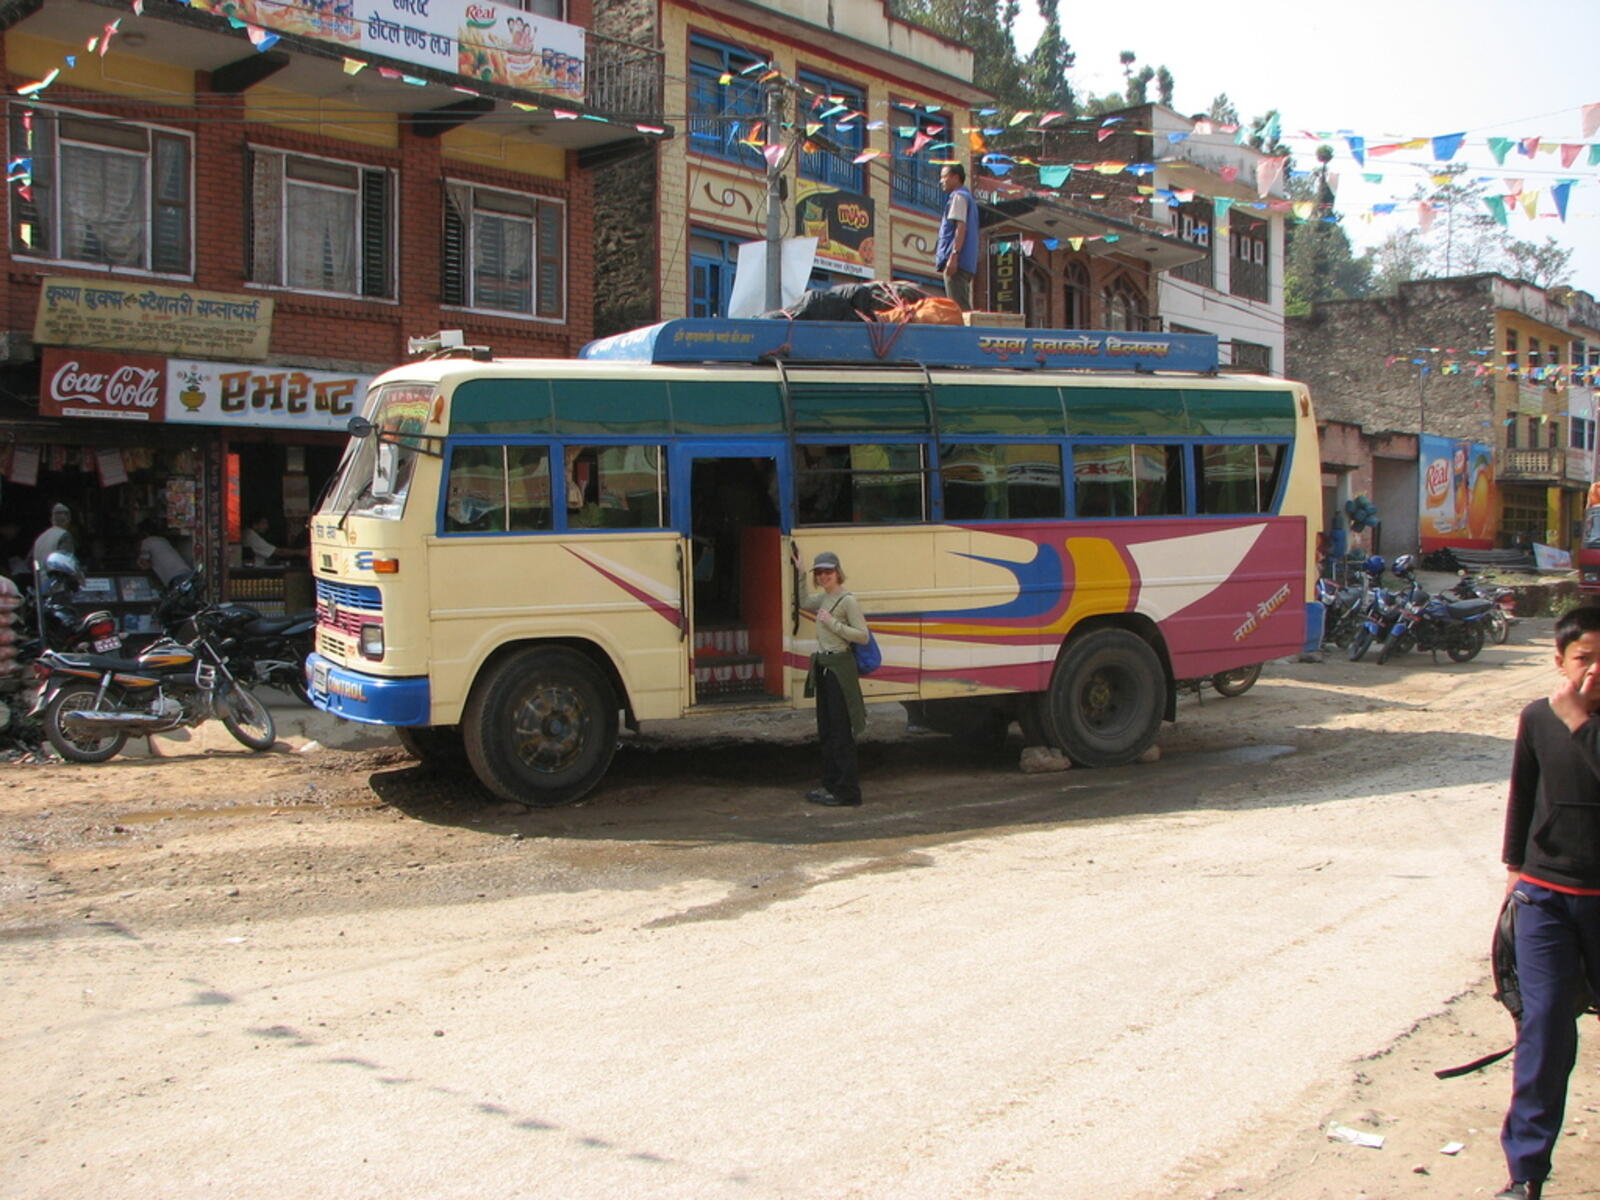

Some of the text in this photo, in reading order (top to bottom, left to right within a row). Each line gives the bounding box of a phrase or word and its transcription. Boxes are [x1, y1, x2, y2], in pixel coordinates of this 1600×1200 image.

[368, 11, 400, 43] होटल
[404, 25, 427, 50] एण्ड
[430, 32, 452, 57] लज
[84, 288, 125, 311] बुक्स
[978, 335, 1028, 362] रसुवा
